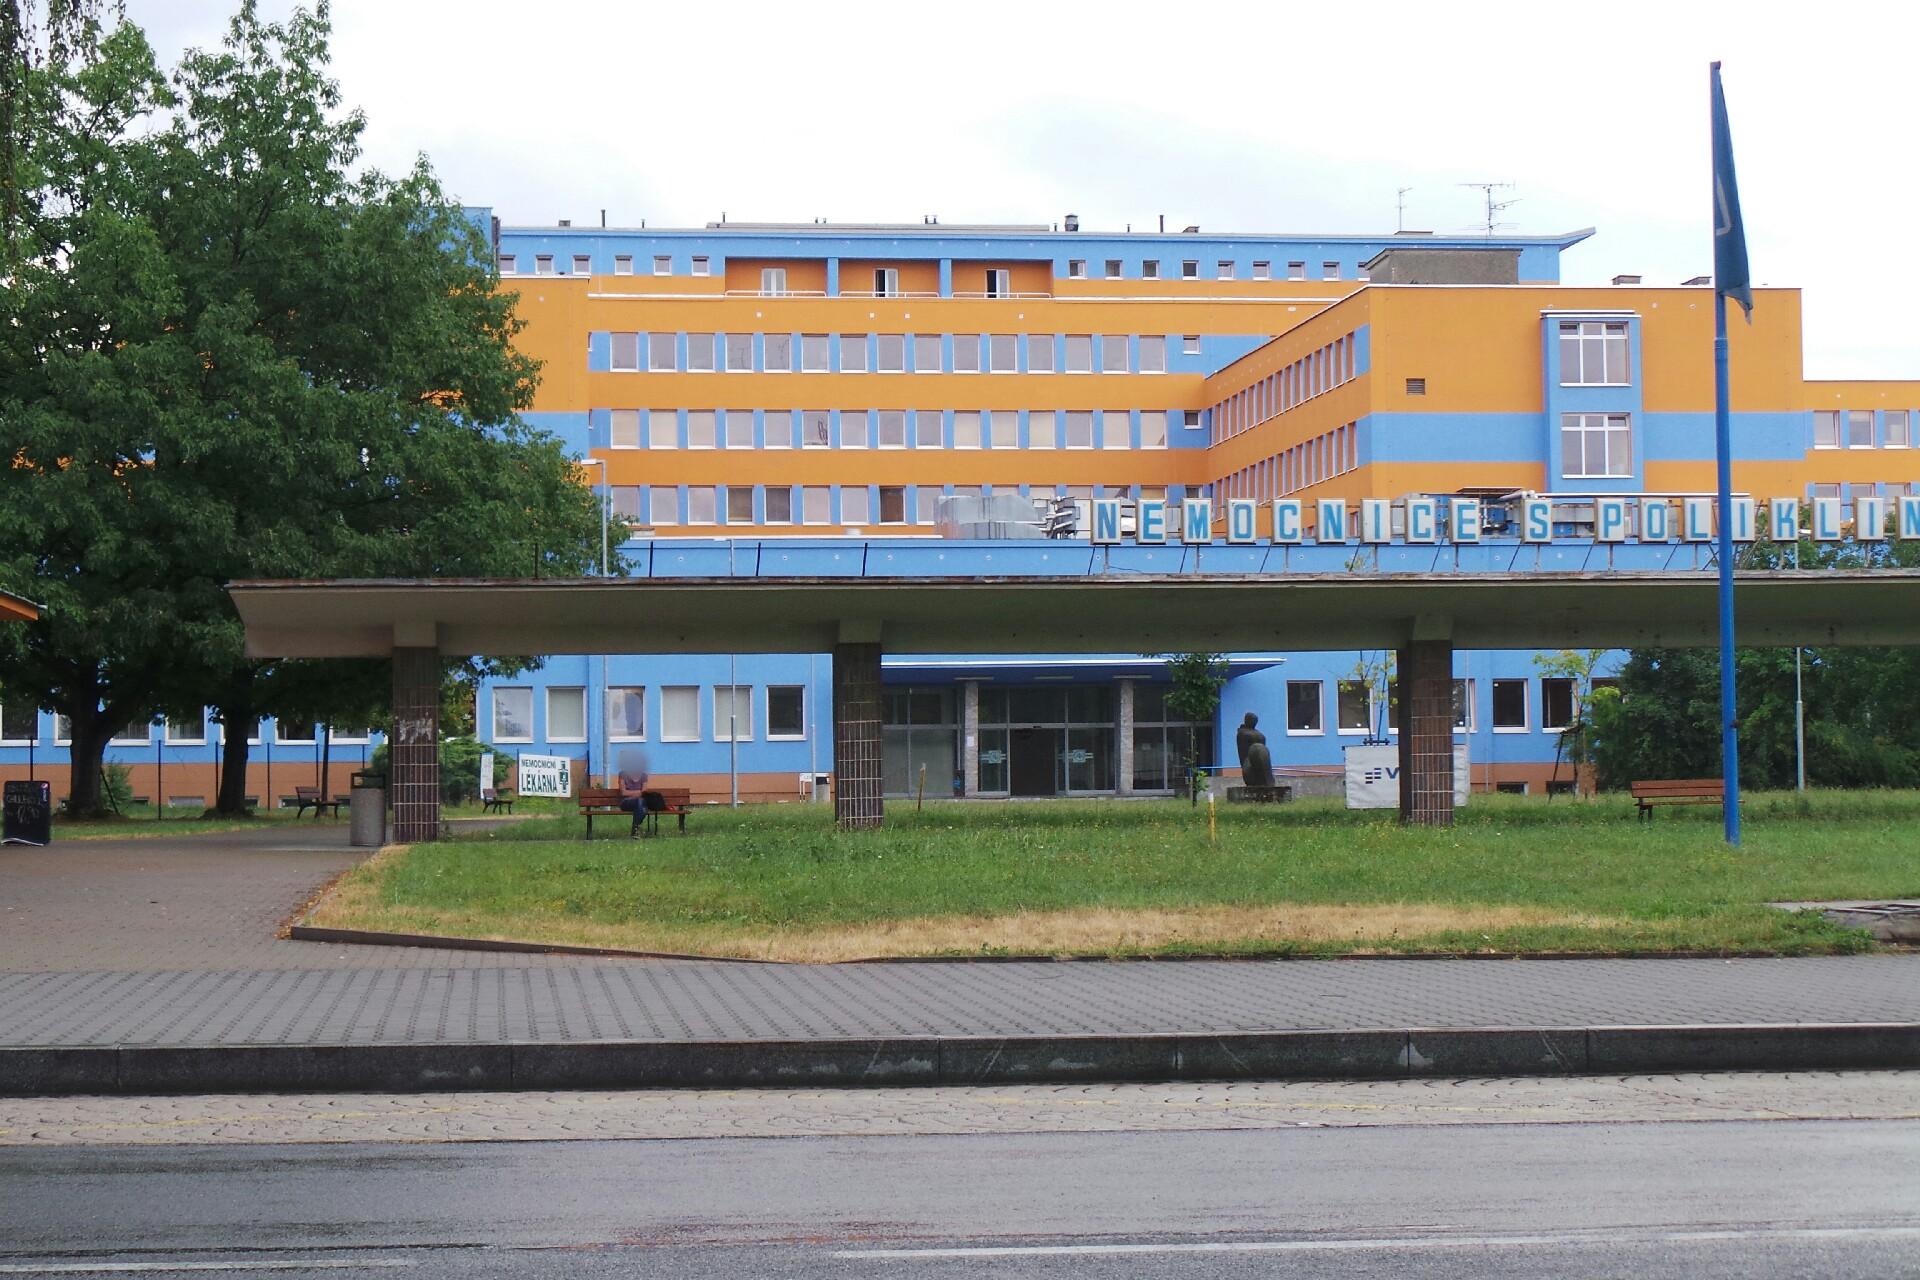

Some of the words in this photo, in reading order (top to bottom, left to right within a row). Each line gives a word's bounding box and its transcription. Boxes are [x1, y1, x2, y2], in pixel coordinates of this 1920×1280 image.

[1097, 503, 1477, 540] NEMOCNICE
[1529, 503, 1549, 539] S
[521, 769, 558, 793] LÉKÁRNA
